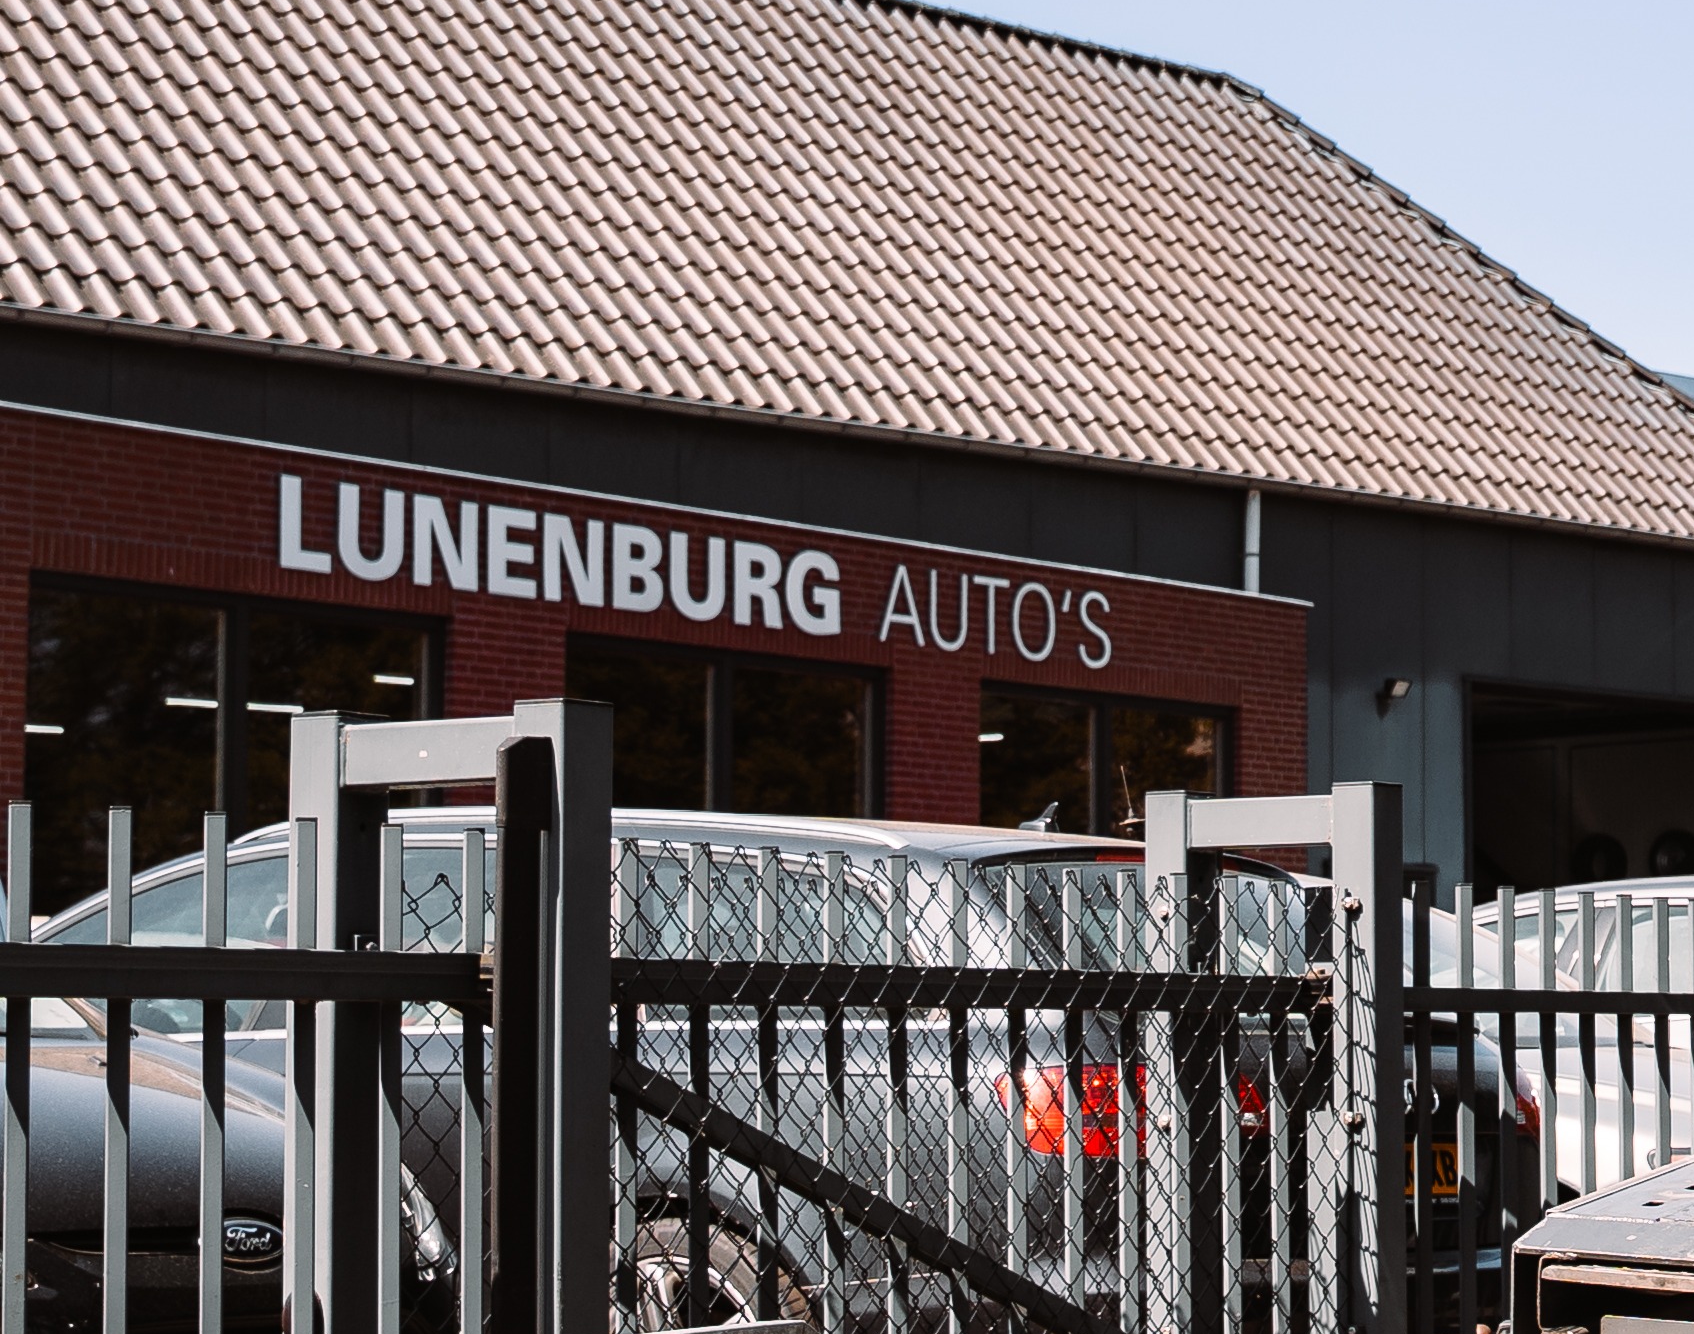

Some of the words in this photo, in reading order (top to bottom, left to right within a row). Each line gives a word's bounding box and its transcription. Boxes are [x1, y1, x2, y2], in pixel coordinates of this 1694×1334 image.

[279, 473, 841, 636] LUNENBURG
[879, 565, 1112, 669] AUTO'S
[225, 1226, 272, 1252] Ford
